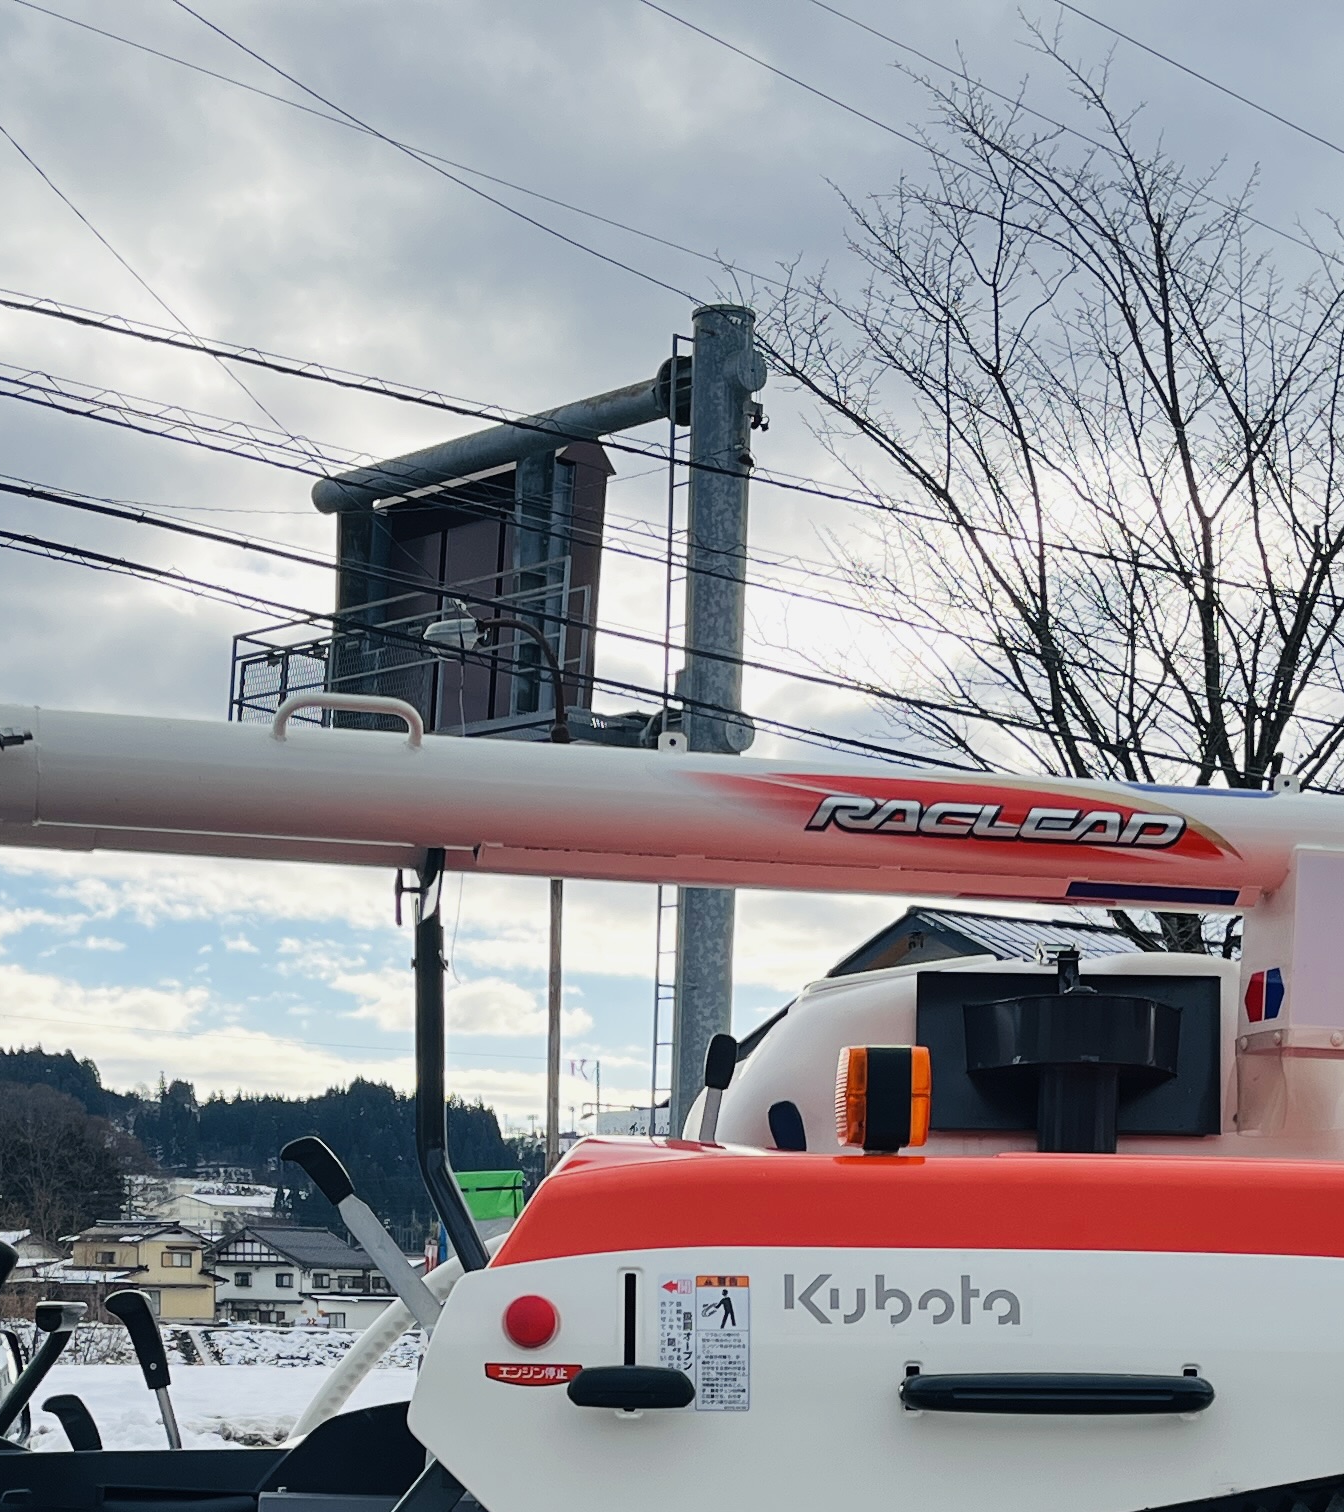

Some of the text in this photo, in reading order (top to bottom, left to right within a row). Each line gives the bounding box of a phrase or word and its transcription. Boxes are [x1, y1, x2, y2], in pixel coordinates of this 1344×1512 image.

[804, 795, 1188, 849] RACLEAD
[784, 1274, 1020, 1325] Kubota
[498, 1367, 567, 1379] エンジン停止
